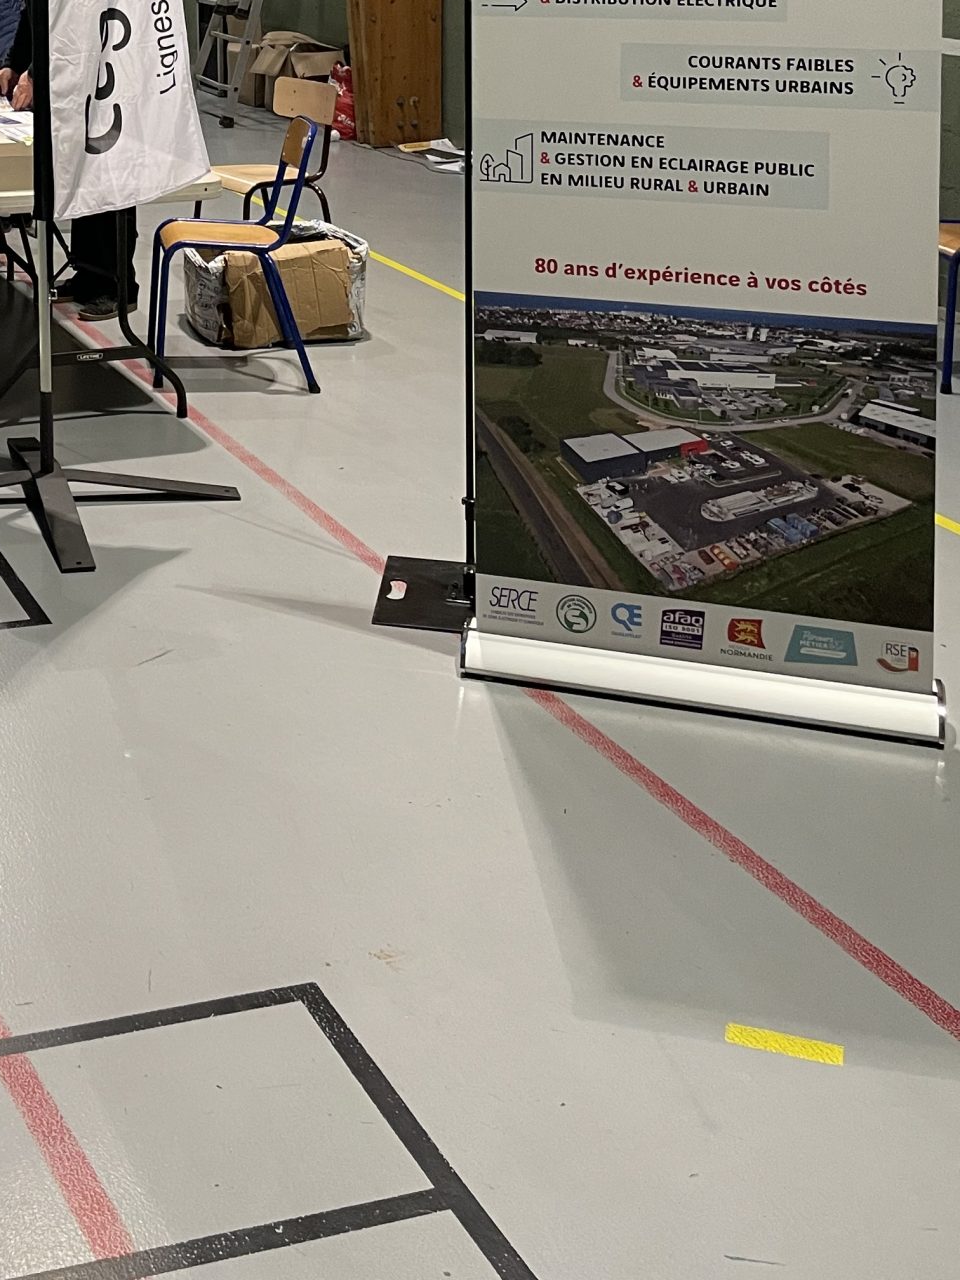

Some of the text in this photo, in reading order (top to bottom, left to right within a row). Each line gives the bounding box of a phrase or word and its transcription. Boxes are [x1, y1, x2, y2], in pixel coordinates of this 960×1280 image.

[151, 0, 178, 95] Lignes
[688, 55, 854, 73] COURANTS FAIBLES
[632, 72, 854, 95] & ÉQUIPEMENTS URBAINS
[541, 131, 665, 148] MAINTENANCE
[540, 152, 815, 177] & GESTION EN ECLAIRAGE PUBLIC
[541, 173, 769, 197] EN MILIEU RURAL & URBAIN
[534, 257, 558, 274] 80
[563, 263, 599, 277] ans
[746, 271, 759, 289] à
[765, 275, 802, 291] vos
[807, 276, 867, 296] côtés
[489, 586, 539, 613] SERCE
[663, 611, 703, 627] afaq
[720, 648, 773, 662] NORMANDIE
[885, 642, 907, 658] RSE
